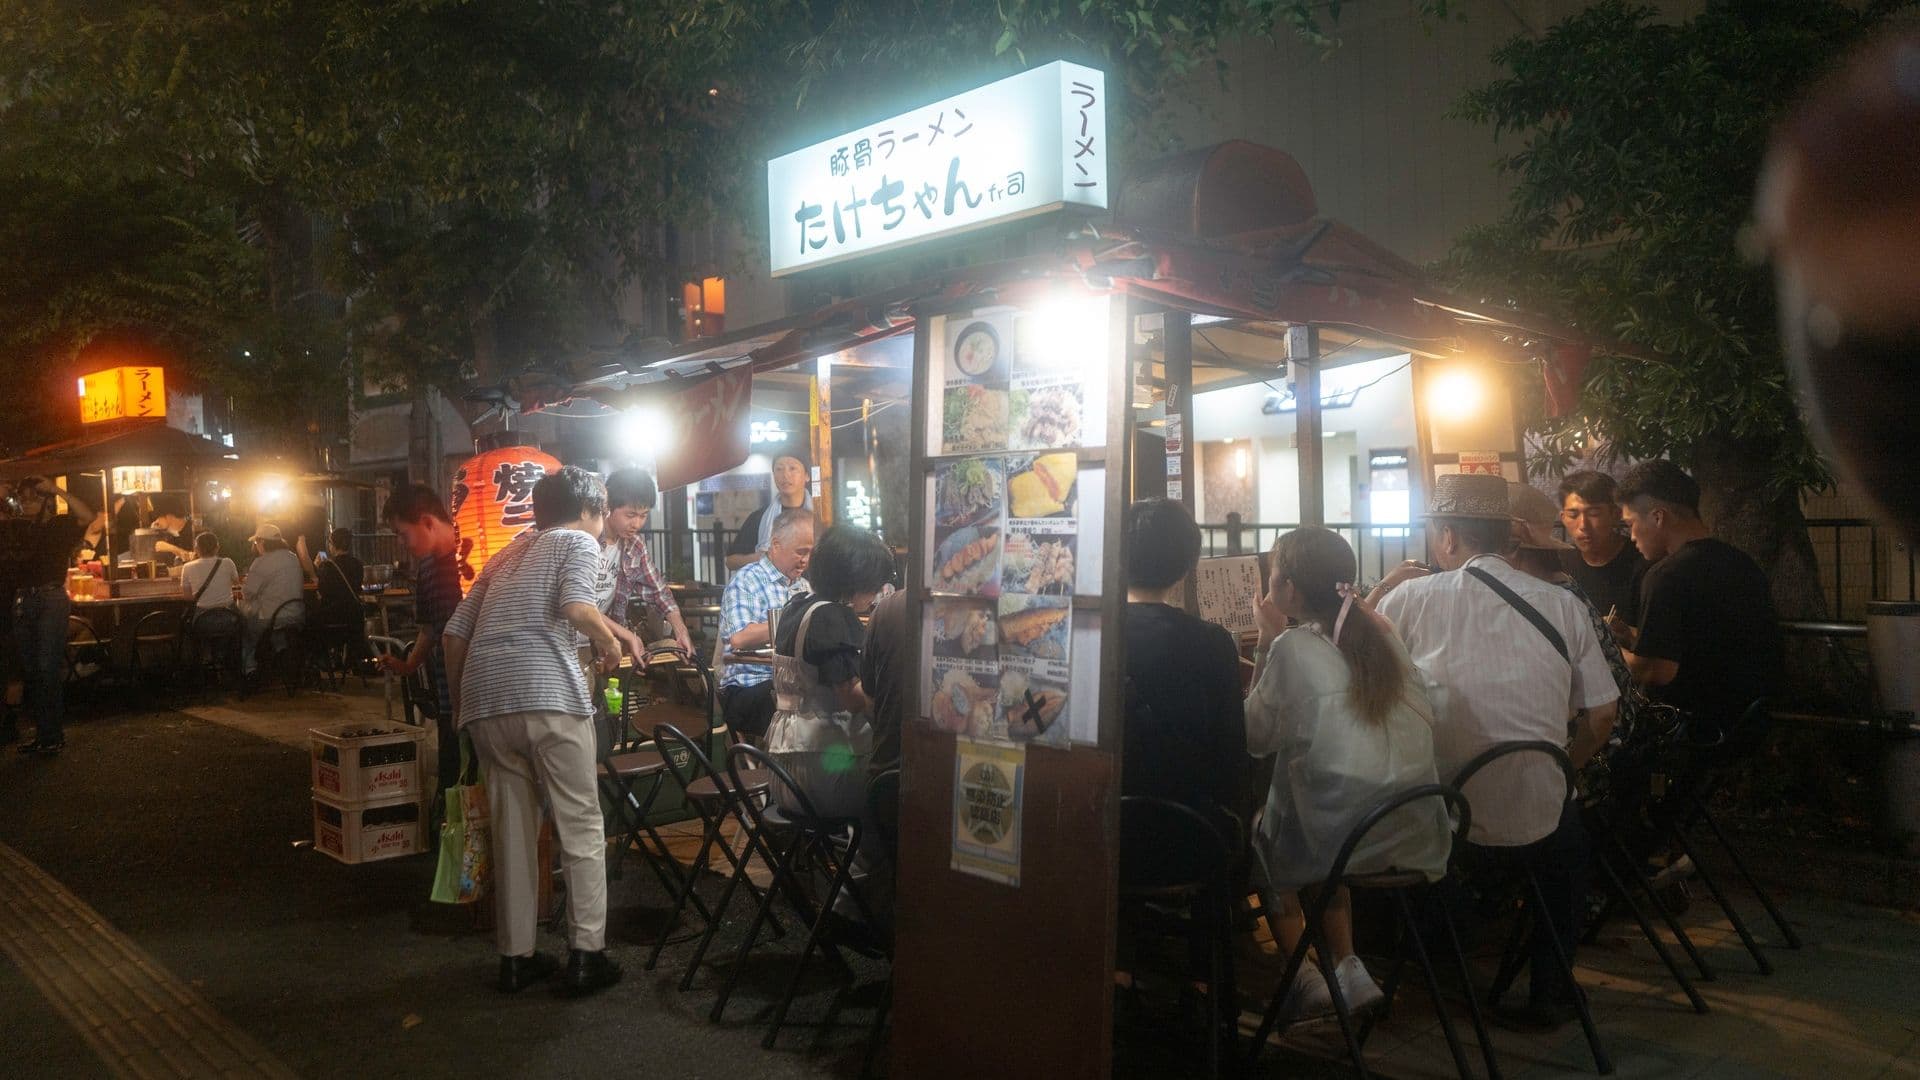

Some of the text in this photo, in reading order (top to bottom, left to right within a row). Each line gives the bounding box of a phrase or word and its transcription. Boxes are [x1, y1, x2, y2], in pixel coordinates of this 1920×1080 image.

[829, 107, 974, 177] 豚骨ラーメン
[1071, 81, 1098, 189] ラーメン
[794, 156, 983, 255] たけちゃん
[135, 368, 153, 417] ラーメン
[374, 768, 401, 783] Asahi
[377, 830, 404, 844] Asahi
